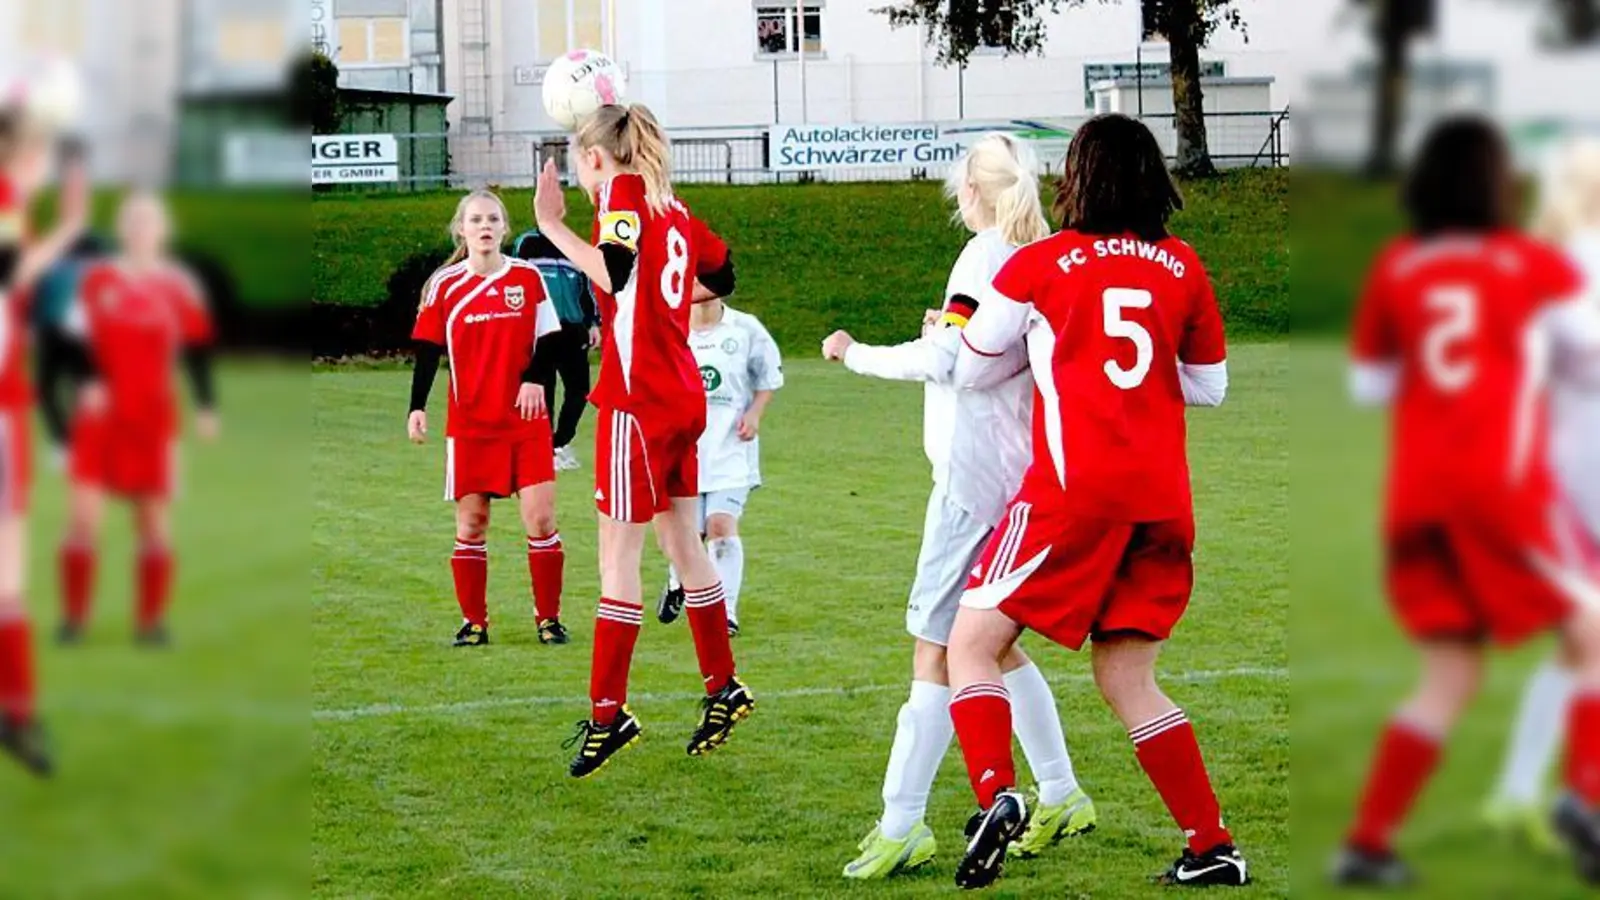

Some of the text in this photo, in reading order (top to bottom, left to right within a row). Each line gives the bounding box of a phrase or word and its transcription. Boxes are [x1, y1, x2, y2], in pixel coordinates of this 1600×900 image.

[783, 125, 939, 144] Autolackiererei
[780, 147, 906, 166] Schwärzer
[339, 168, 384, 178] GMBH
[615, 219, 631, 240] C
[660, 225, 688, 310] 8
[1056, 238, 1186, 279] FC SCHWAIG
[1102, 287, 1154, 390] 5
